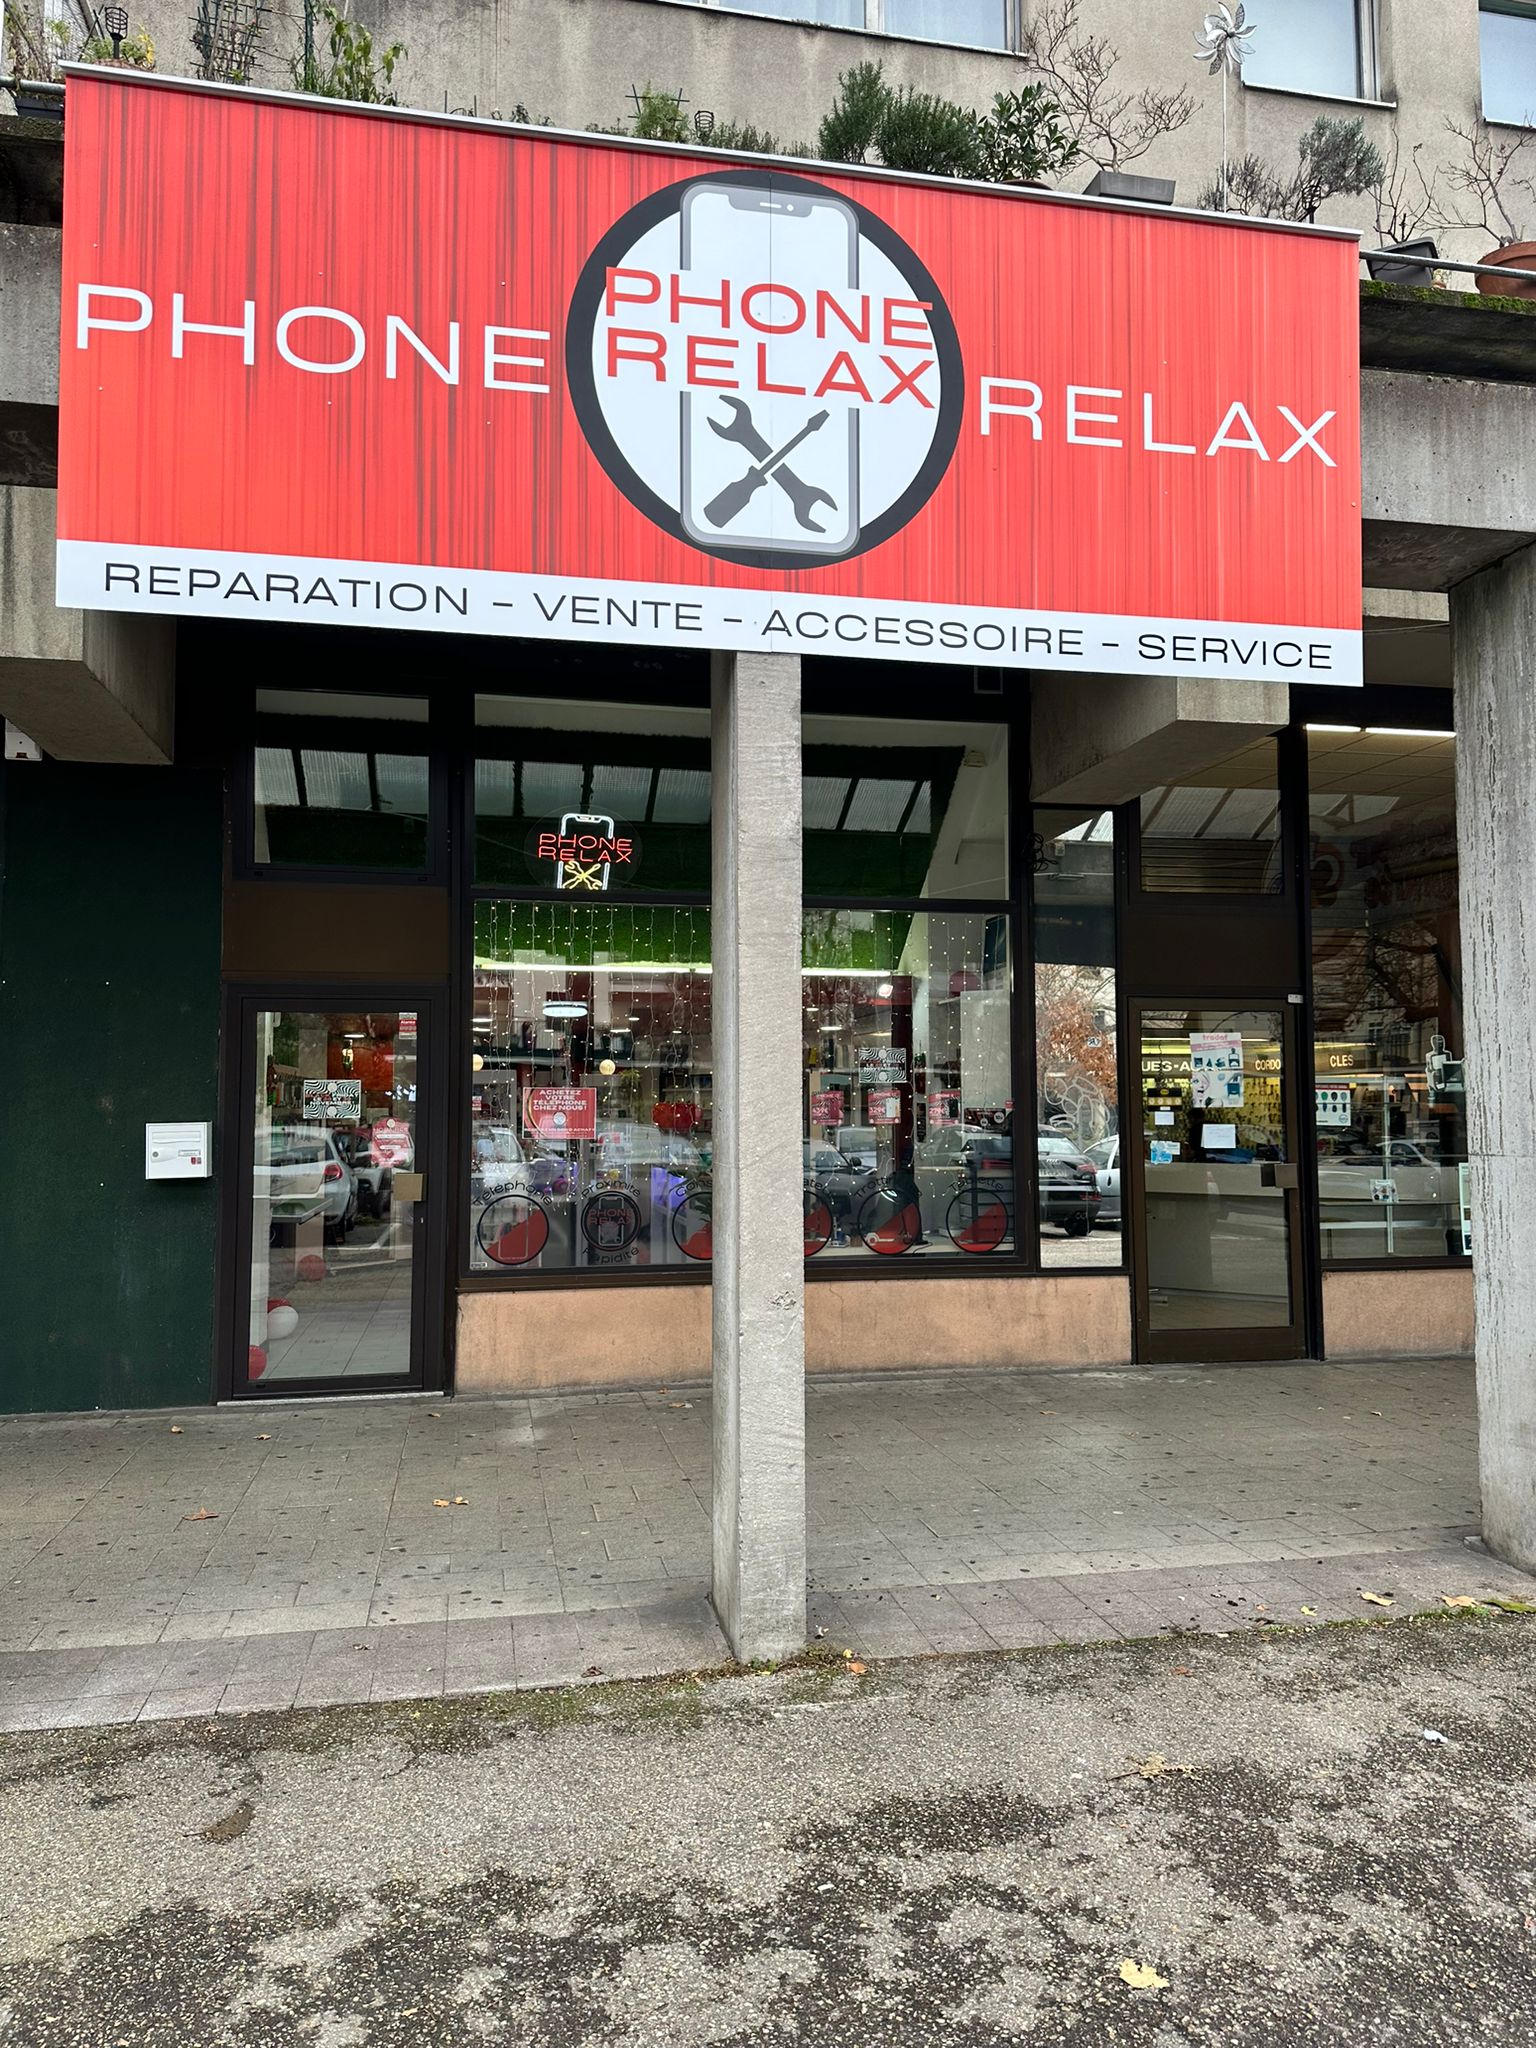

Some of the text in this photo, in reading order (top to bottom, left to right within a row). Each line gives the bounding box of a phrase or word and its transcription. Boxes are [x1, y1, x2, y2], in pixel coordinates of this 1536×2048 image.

[606, 267, 934, 350] PHONE
[77, 284, 1338, 467] PHONE RELAX
[607, 327, 935, 409] RELAX
[105, 562, 468, 616] REPARATION
[533, 592, 703, 632] VENTE
[761, 609, 1084, 656] ACCESSOIRE
[1138, 633, 1332, 669] SERVICE
[538, 845, 632, 864] RELAX
[539, 833, 633, 851] PHONE
[1330, 1055, 1354, 1067] CLES
